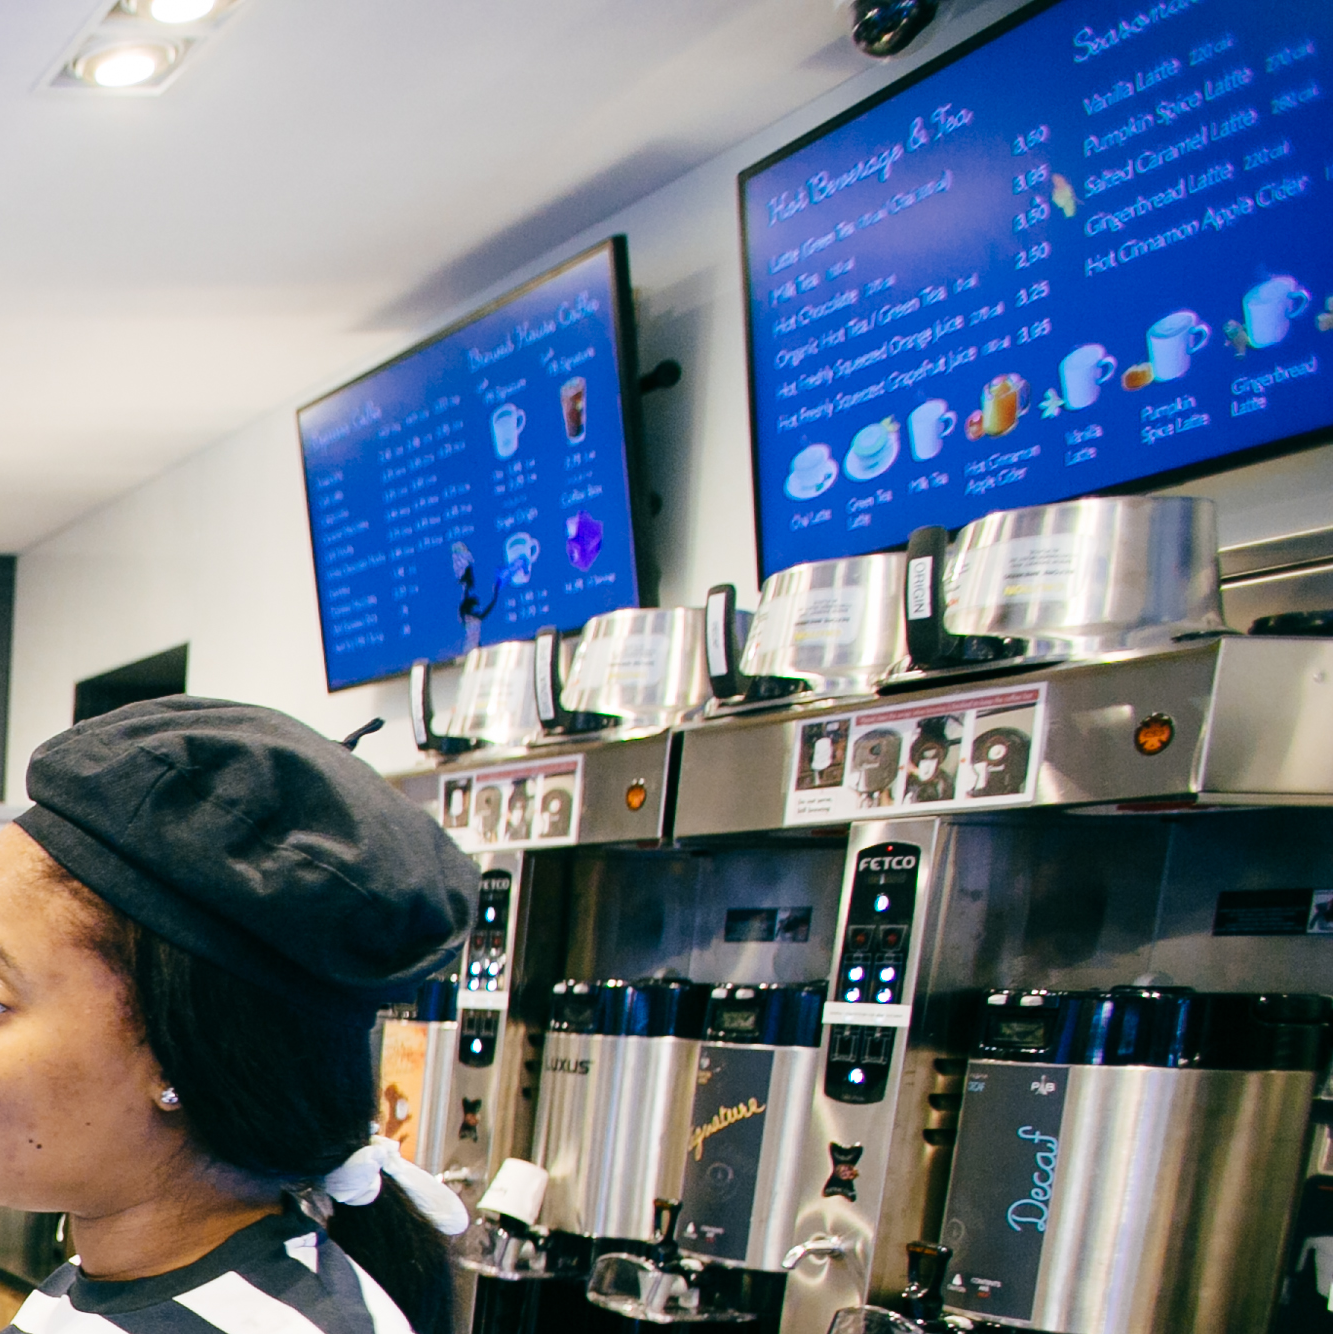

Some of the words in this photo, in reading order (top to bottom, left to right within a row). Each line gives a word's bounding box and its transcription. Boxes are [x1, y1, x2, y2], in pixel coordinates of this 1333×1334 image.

[1073, 0, 1201, 63] Seasona
[1083, 81, 1134, 115] Vanilla
[1136, 57, 1181, 92] Latte
[1084, 114, 1154, 157] Pumpkin
[1156, 91, 1203, 125] Spice
[1204, 67, 1254, 101] Latte
[1085, 159, 1133, 199] Salted
[1135, 125, 1208, 174] Caramel
[1210, 108, 1259, 141] Latte
[767, 189, 808, 229] Hot
[1085, 178, 1186, 237] Gingerbread
[1188, 162, 1234, 194] Latte
[1085, 250, 1117, 277] Hot
[1117, 220, 1199, 264] Cinnamon
[1202, 196, 1255, 232] Apple
[1255, 176, 1309, 209] Cider
[797, 289, 859, 327] Chocolate
[877, 297, 920, 326] Green
[919, 286, 947, 309] Tea
[1014, 241, 1052, 271] 2.50
[1231, 354, 1319, 395] Gingerbread
[1139, 394, 1196, 424] Pumpkin
[1140, 422, 1175, 446] Spice
[1175, 412, 1211, 434] Latte
[1230, 395, 1268, 418] Latte
[912, 560, 927, 615] ORIGIN
[859, 856, 916, 872] FETCO
[1006, 1125, 1059, 1233] Decaf
